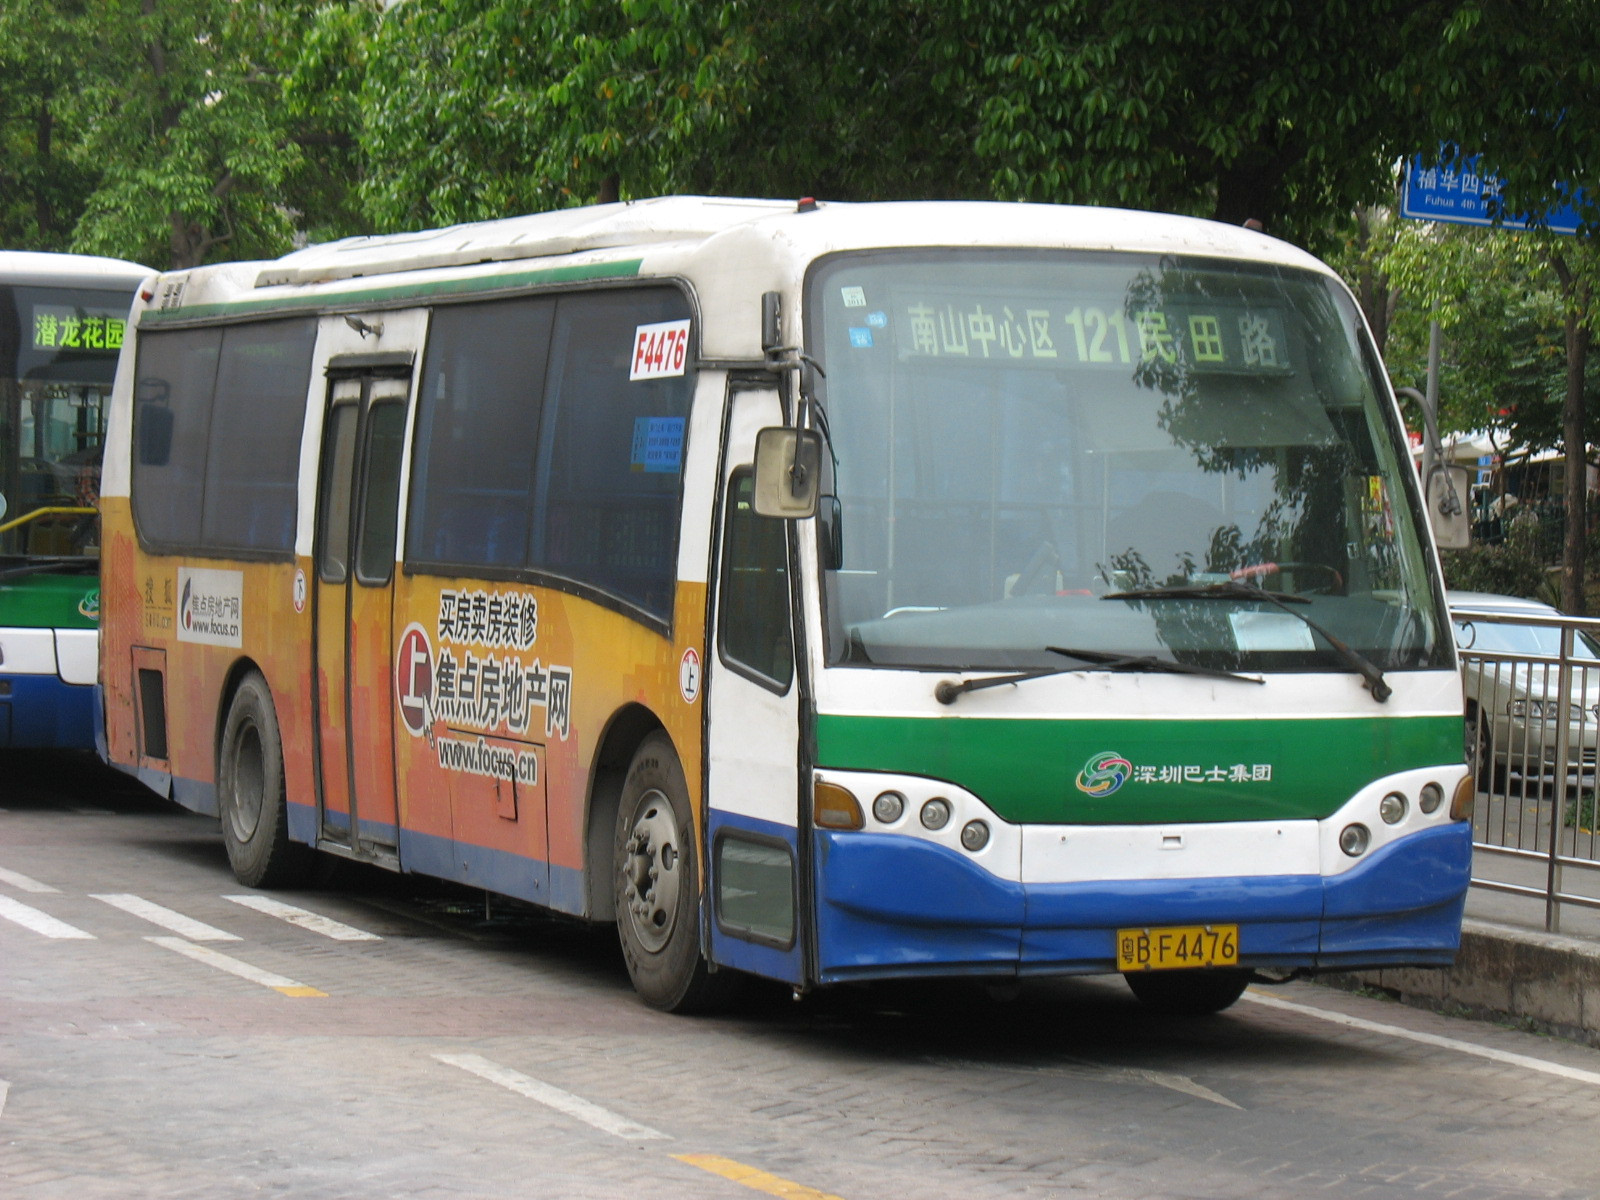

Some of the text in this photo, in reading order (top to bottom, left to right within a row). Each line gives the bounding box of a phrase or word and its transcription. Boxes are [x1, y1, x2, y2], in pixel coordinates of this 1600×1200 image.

[1418, 168, 1502, 197] 福华四路
[1425, 195, 1455, 208] Fuhua
[1461, 199, 1475, 210] 4th
[35, 314, 126, 349] 潜龙花园
[907, 301, 1278, 367] 南山中心区 121 民田路
[634, 329, 686, 373] F4476
[191, 594, 239, 619] 焦点房地产网
[438, 589, 537, 649] 买房卖房装修
[192, 619, 239, 637] www.focus.cn
[403, 635, 429, 710] 上
[684, 664, 696, 693] 上
[436, 649, 572, 740] 焦点房地产网
[438, 737, 537, 785] www.focus.cn
[1133, 763, 1273, 783] 深圳巴士集团
